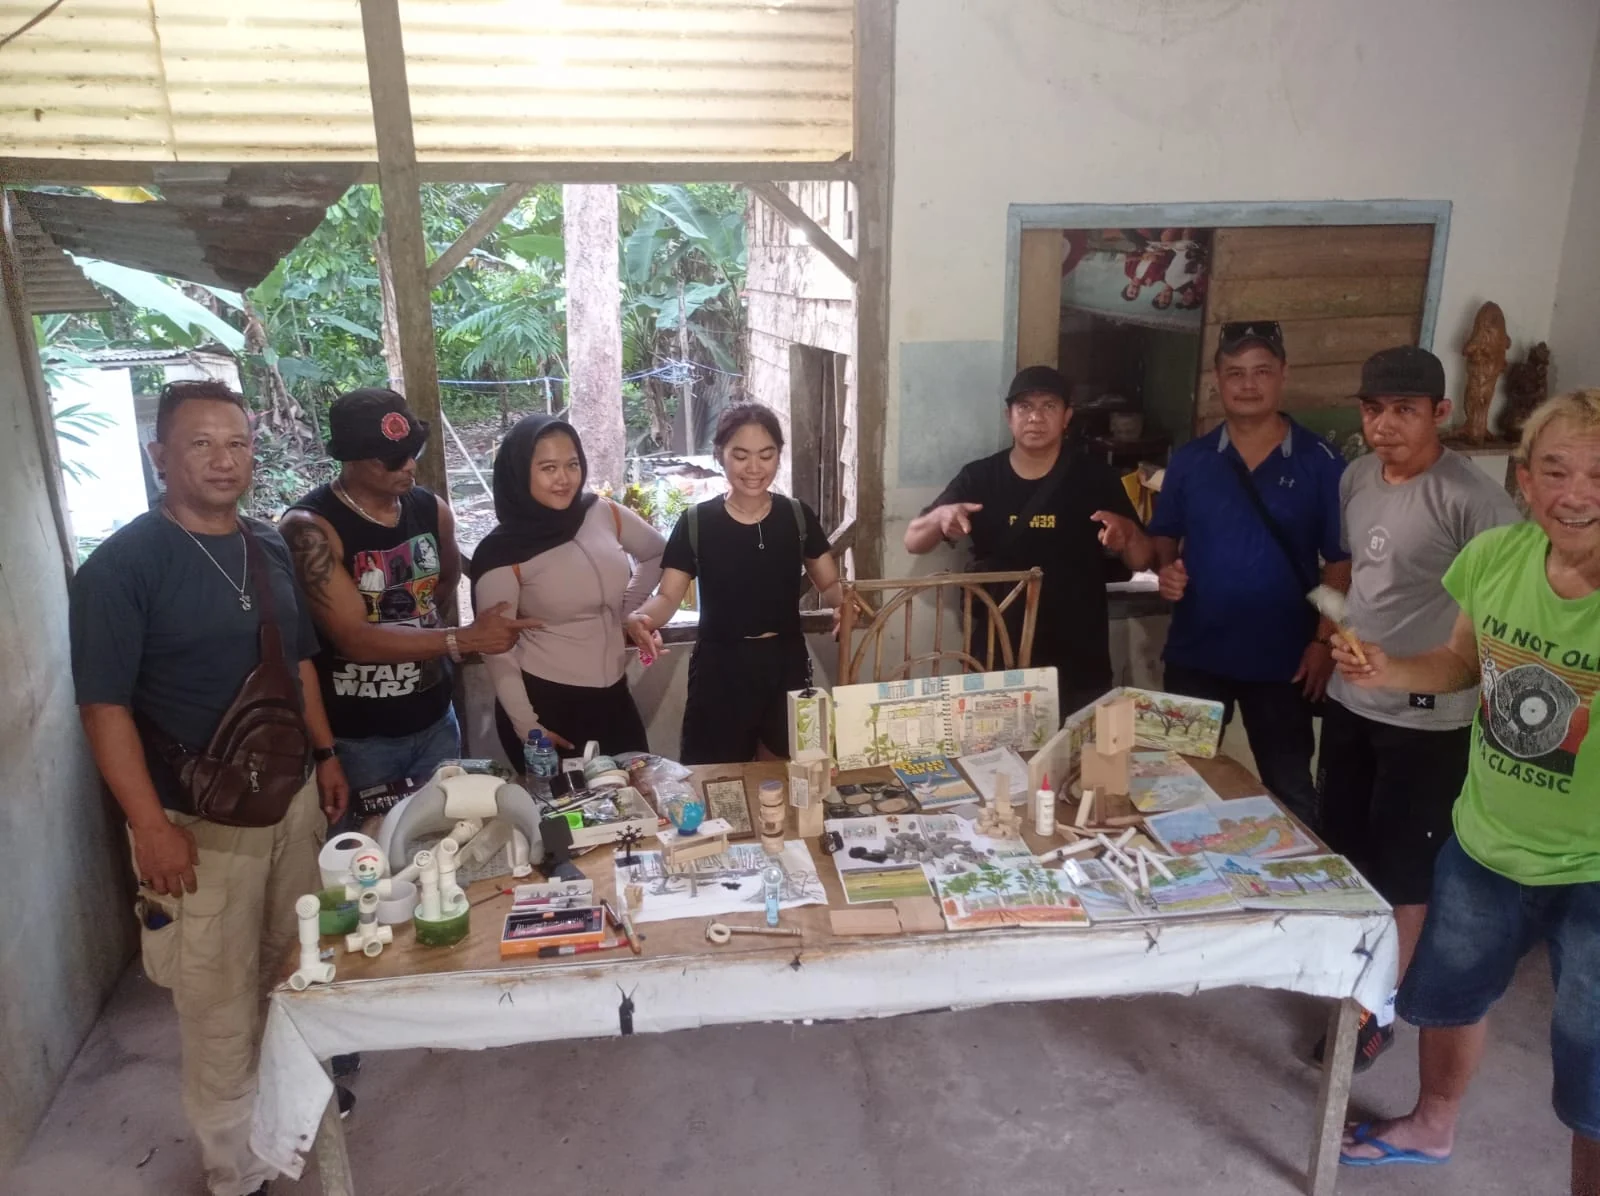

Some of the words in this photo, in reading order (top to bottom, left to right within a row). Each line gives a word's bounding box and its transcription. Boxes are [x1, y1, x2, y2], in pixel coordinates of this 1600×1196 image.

[1511, 627, 1560, 659] NOT
[1562, 650, 1600, 672] OL
[332, 662, 421, 682] STAR
[332, 674, 420, 698] WARS
[1488, 753, 1572, 795] CLASSIC
